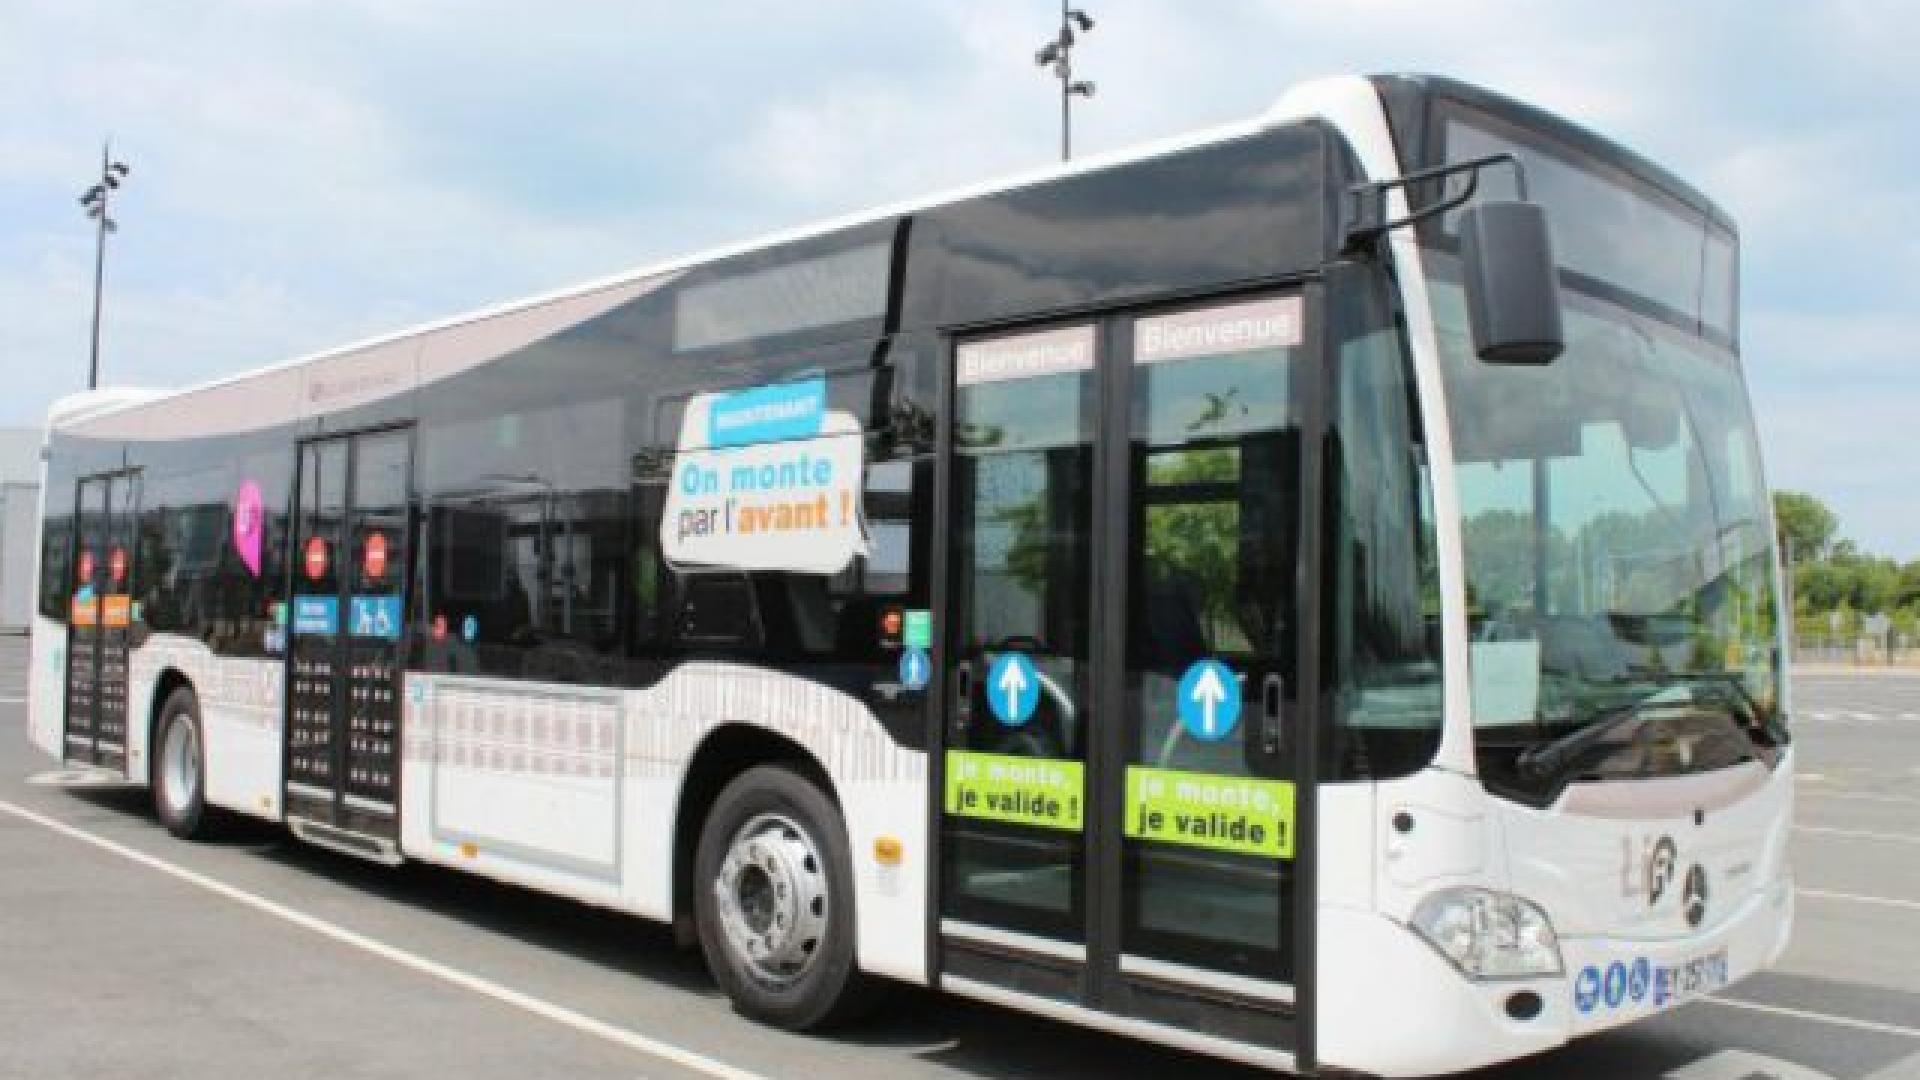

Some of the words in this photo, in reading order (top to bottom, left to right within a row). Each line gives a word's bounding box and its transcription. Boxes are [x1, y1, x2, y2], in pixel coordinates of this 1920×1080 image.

[1144, 313, 1289, 353] Bienvenue
[680, 461, 720, 496] On
[731, 453, 833, 490] monte
[678, 507, 721, 546] par
[956, 784, 978, 812] je
[986, 788, 1060, 819] valide
[1139, 774, 1164, 801] je
[1139, 803, 1165, 836] je
[1174, 812, 1266, 845] valide
